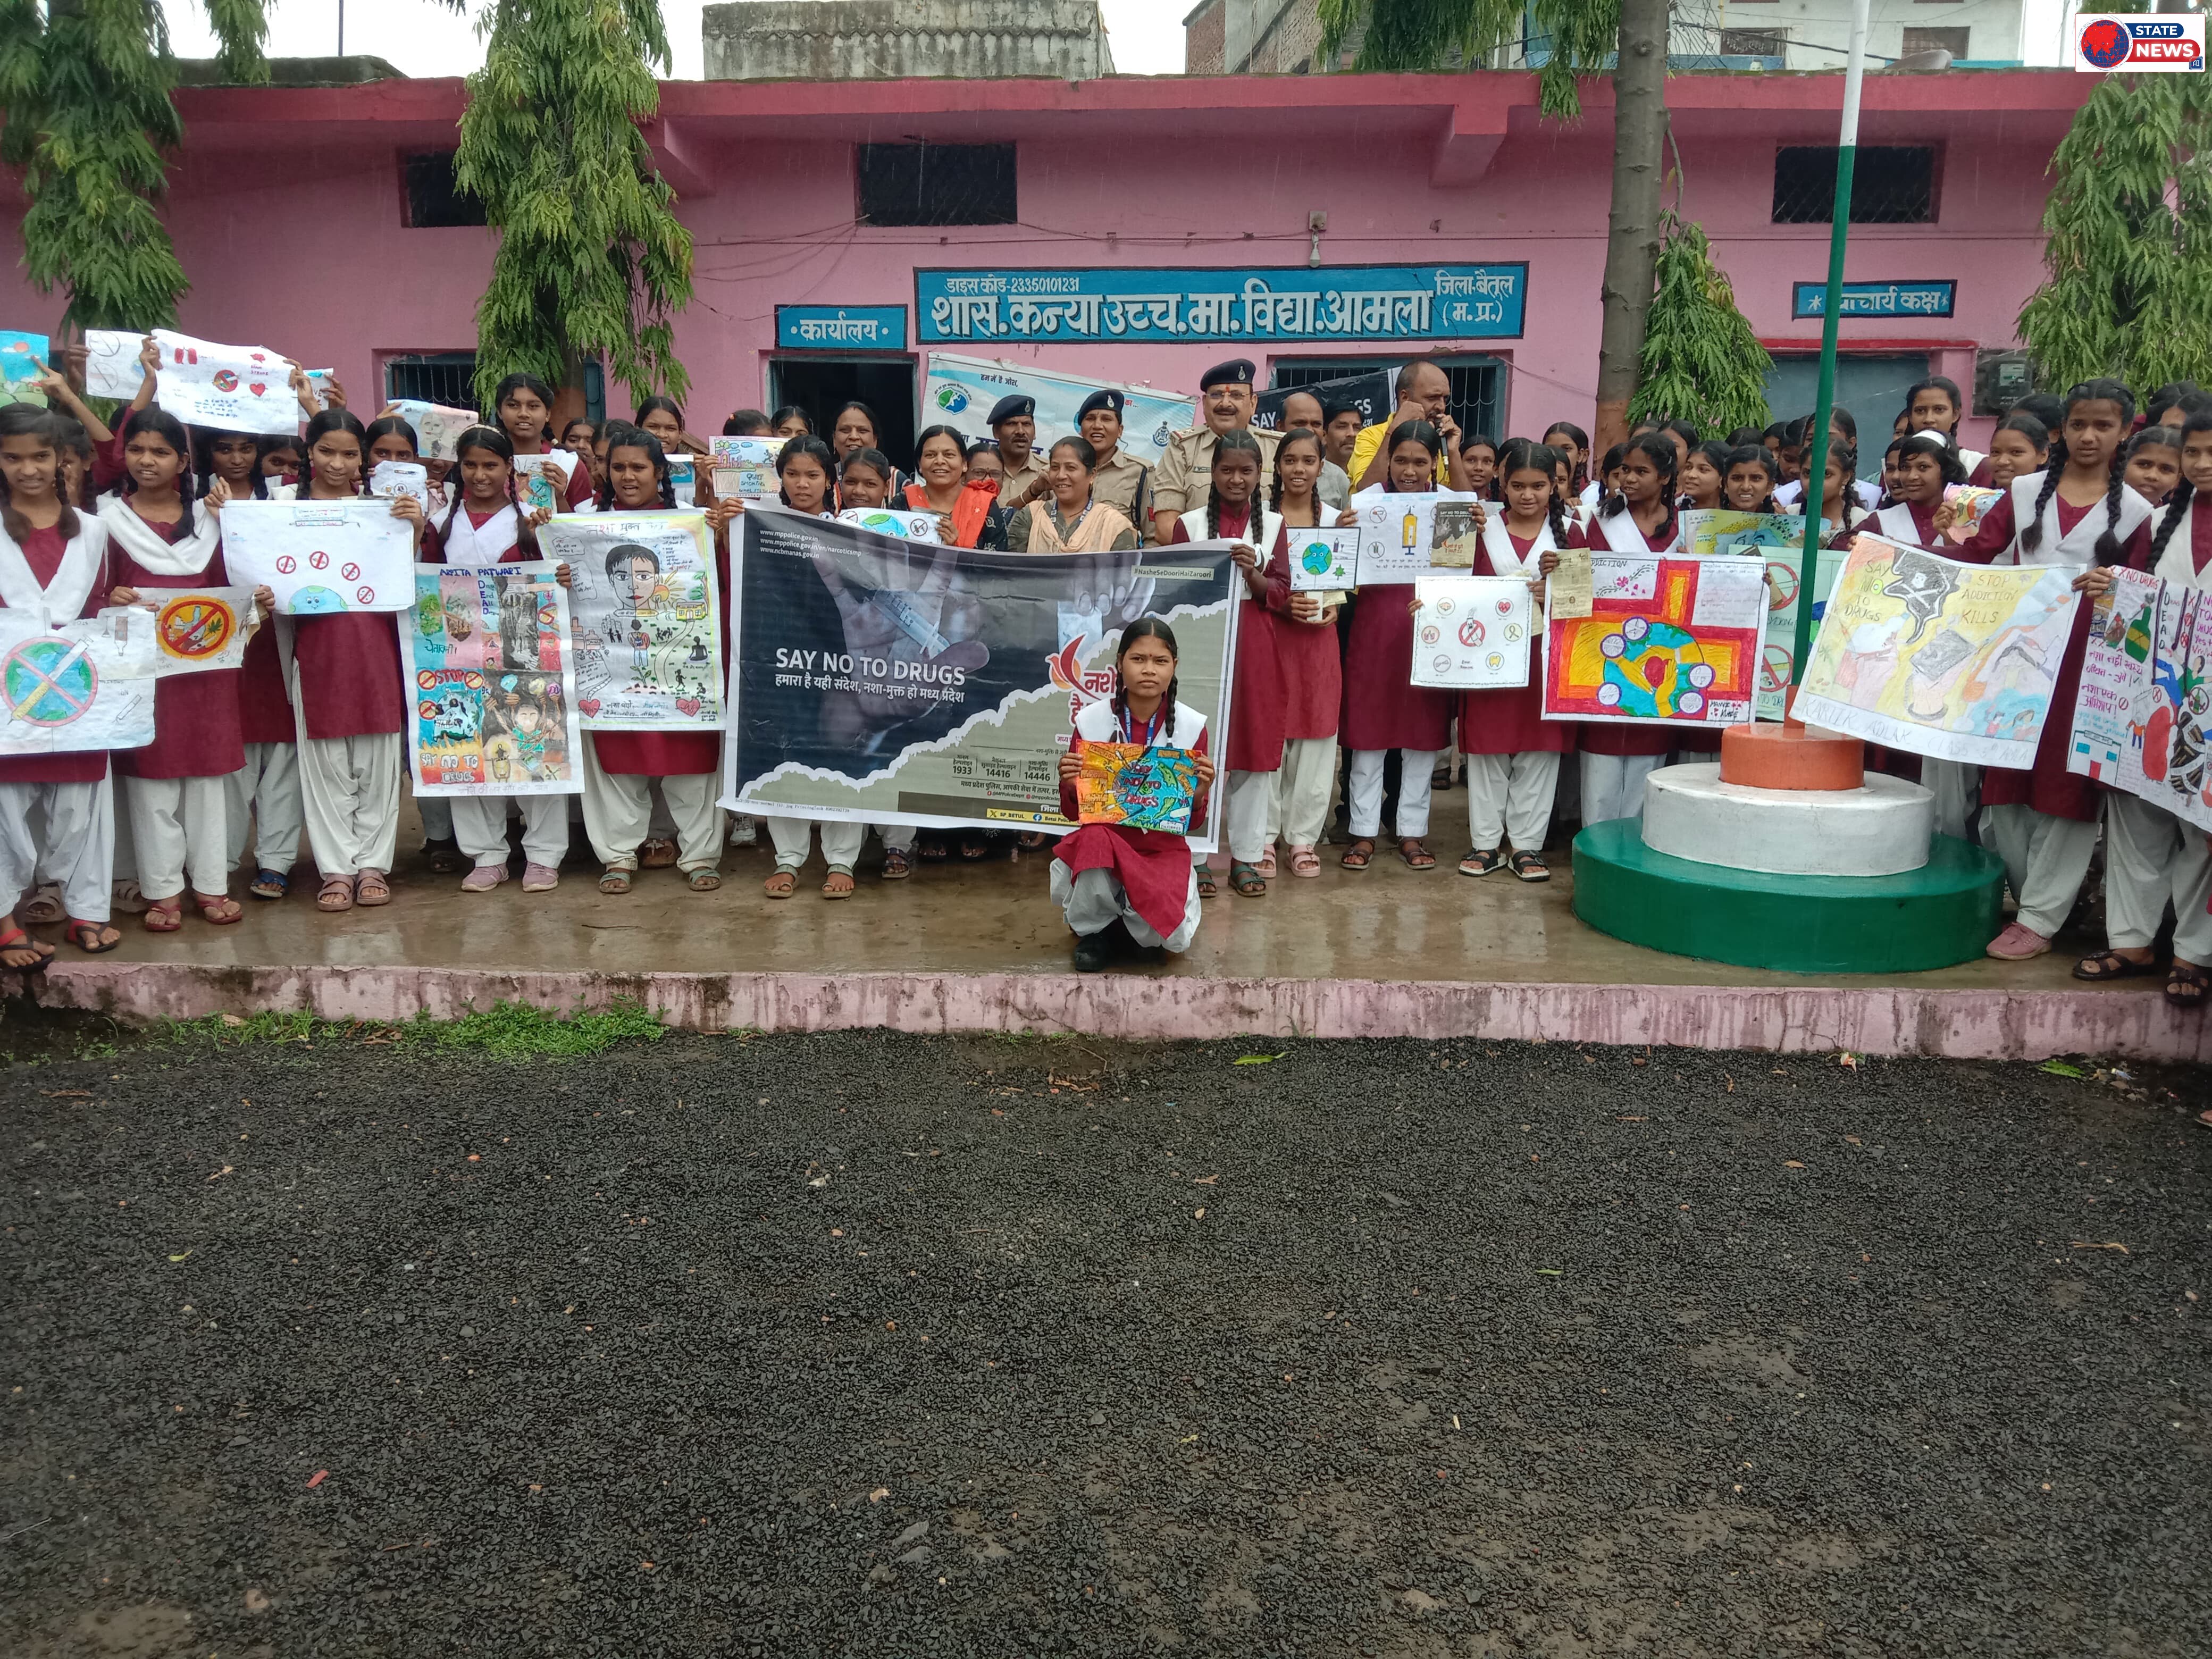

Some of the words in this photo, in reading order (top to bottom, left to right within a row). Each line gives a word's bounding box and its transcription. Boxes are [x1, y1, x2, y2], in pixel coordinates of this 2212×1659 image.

[1901, 290, 1942, 314] कक्ष
[800, 311, 878, 344] कार्यालय
[1251, 411, 1276, 428] SAY
[759, 529, 818, 542] www.mppolice.gov.in
[759, 538, 862, 557] www.mppolice.gov.in/en/narcoticsmp
[759, 546, 819, 559] www.ncbmanas.gov.in
[1134, 567, 1212, 579] #NasheSeDooriHaiZaroori
[1865, 559, 1891, 576] SAY
[1976, 573, 2011, 588] STOP
[2126, 570, 2139, 583] NO
[1858, 575, 1884, 595] NO
[1856, 594, 1870, 606] TO
[1961, 587, 2019, 602] ADDICTION
[1843, 603, 1883, 622] DRUGS
[1960, 610, 1999, 624] KILLS
[776, 647, 817, 670] SAY
[823, 651, 854, 674] NO
[859, 656, 887, 678] TO
[893, 660, 966, 685] DRUGS
[775, 673, 803, 687] हमारा
[805, 671, 812, 689] है
[814, 674, 833, 690] यही
[834, 675, 861, 694] संदेश,
[863, 682, 906, 700] नशा-मुक्त
[907, 683, 917, 700] हो
[919, 688, 940, 700] मध्य
[941, 686, 965, 703] प्रदेश
[952, 766, 973, 775] 1933
[985, 768, 1011, 778] 14416
[1024, 772, 1051, 782] 14446
[985, 782, 1002, 791] पुलिस,
[1040, 804, 1060, 813] जिला
